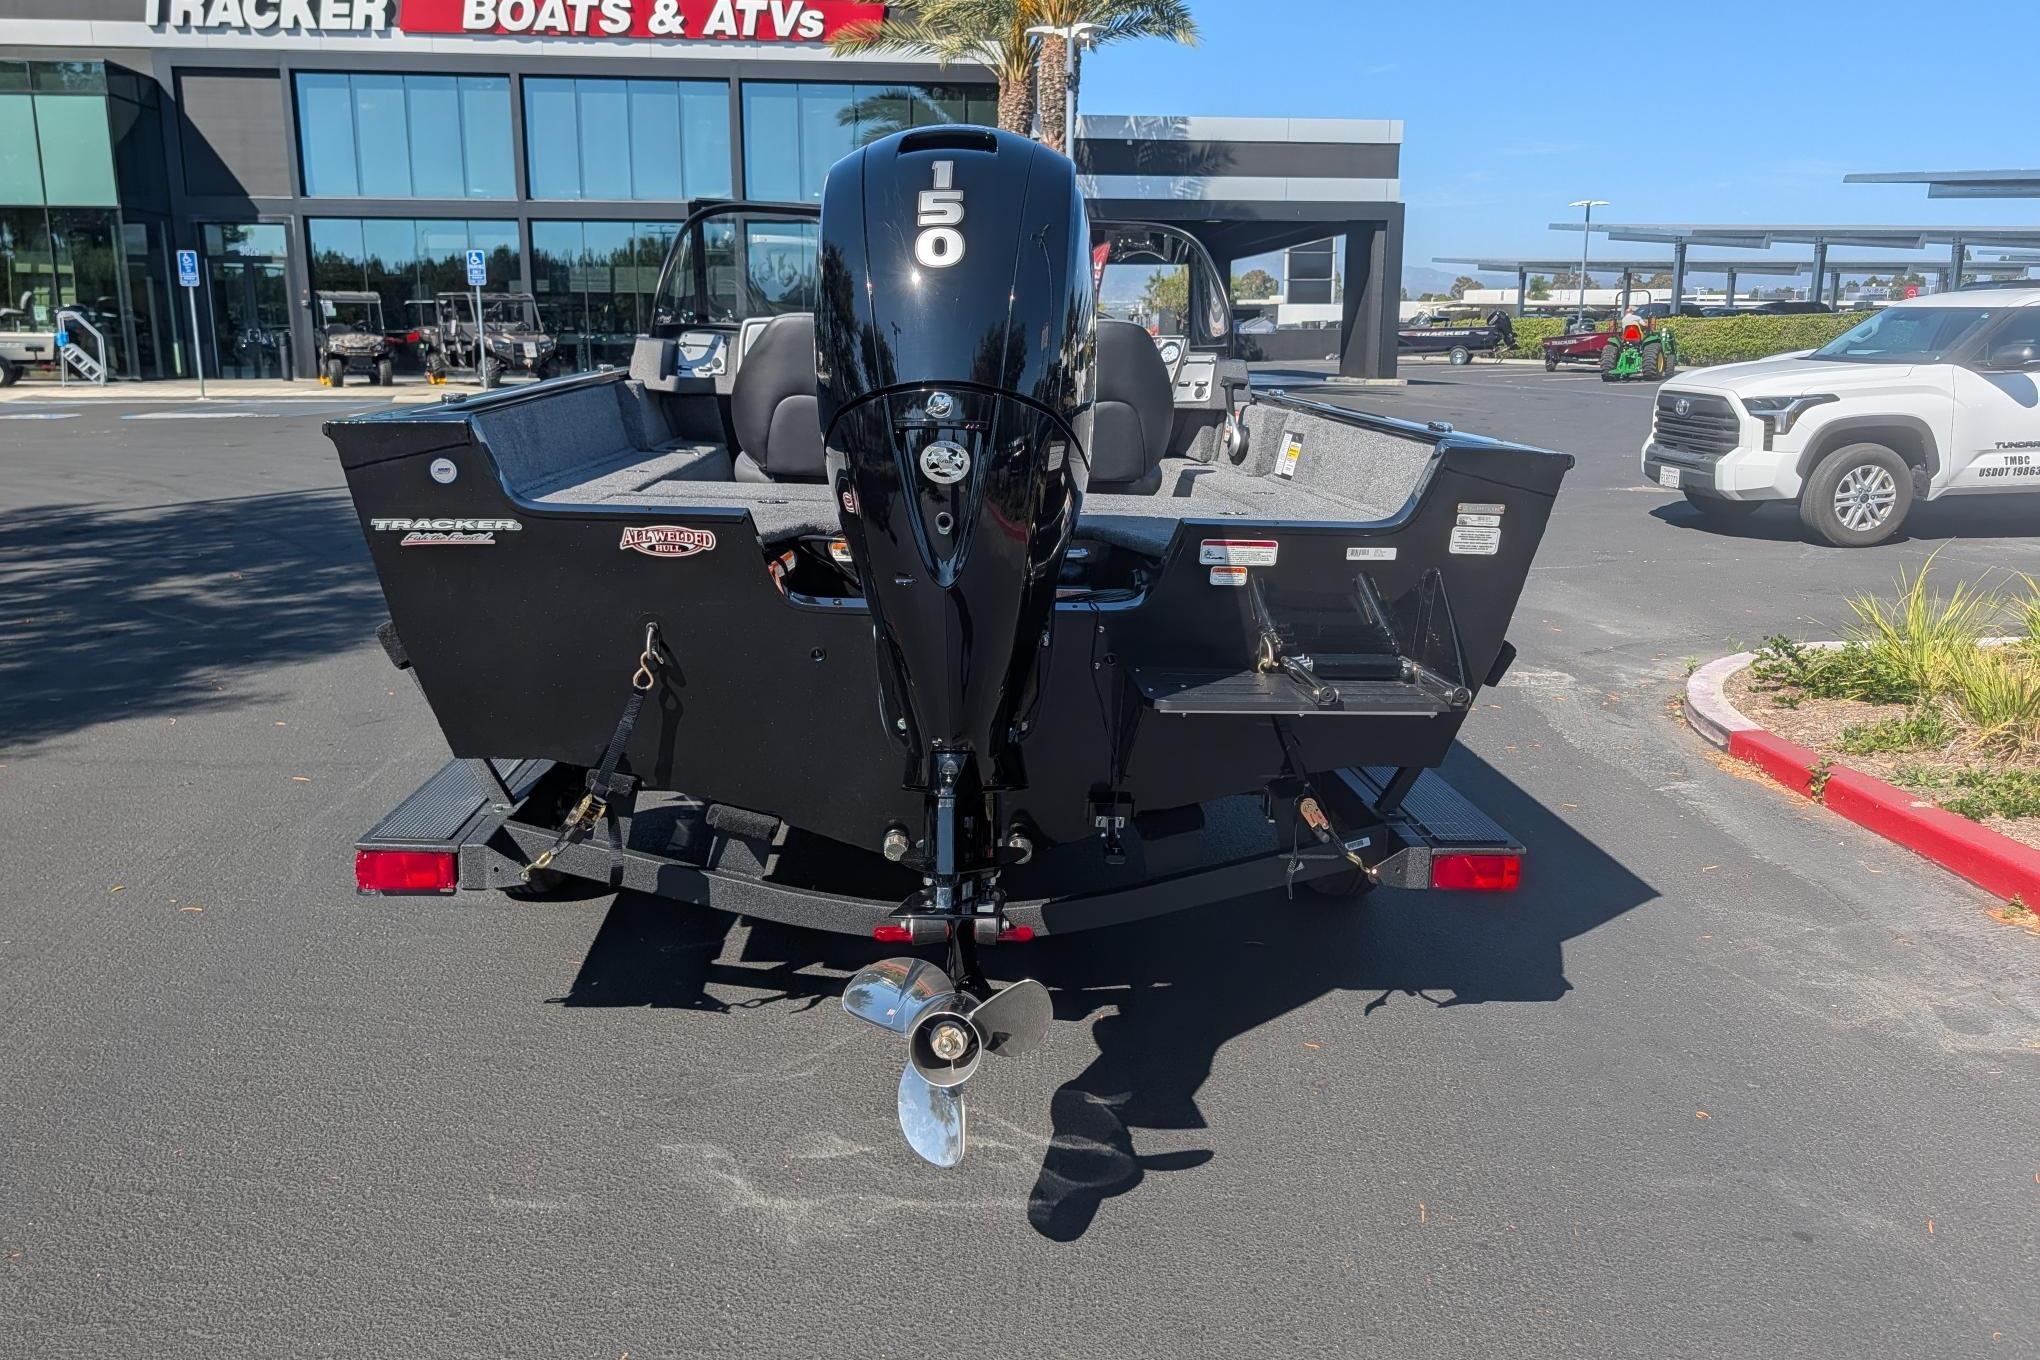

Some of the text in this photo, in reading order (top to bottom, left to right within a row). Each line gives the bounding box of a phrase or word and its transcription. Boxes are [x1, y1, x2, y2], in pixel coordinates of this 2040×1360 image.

[462, 0, 632, 33] BOATS
[648, 0, 685, 35] &
[703, 0, 825, 38] ATVs
[915, 160, 966, 269] 150
[2004, 456, 2030, 465] TMBC
[1979, 467, 2010, 477] USDOT
[372, 518, 518, 530] TRACKER
[406, 532, 426, 541] Fish
[428, 533, 446, 541] the
[623, 529, 713, 547] ALL WELDED
[655, 544, 682, 552] HULL
